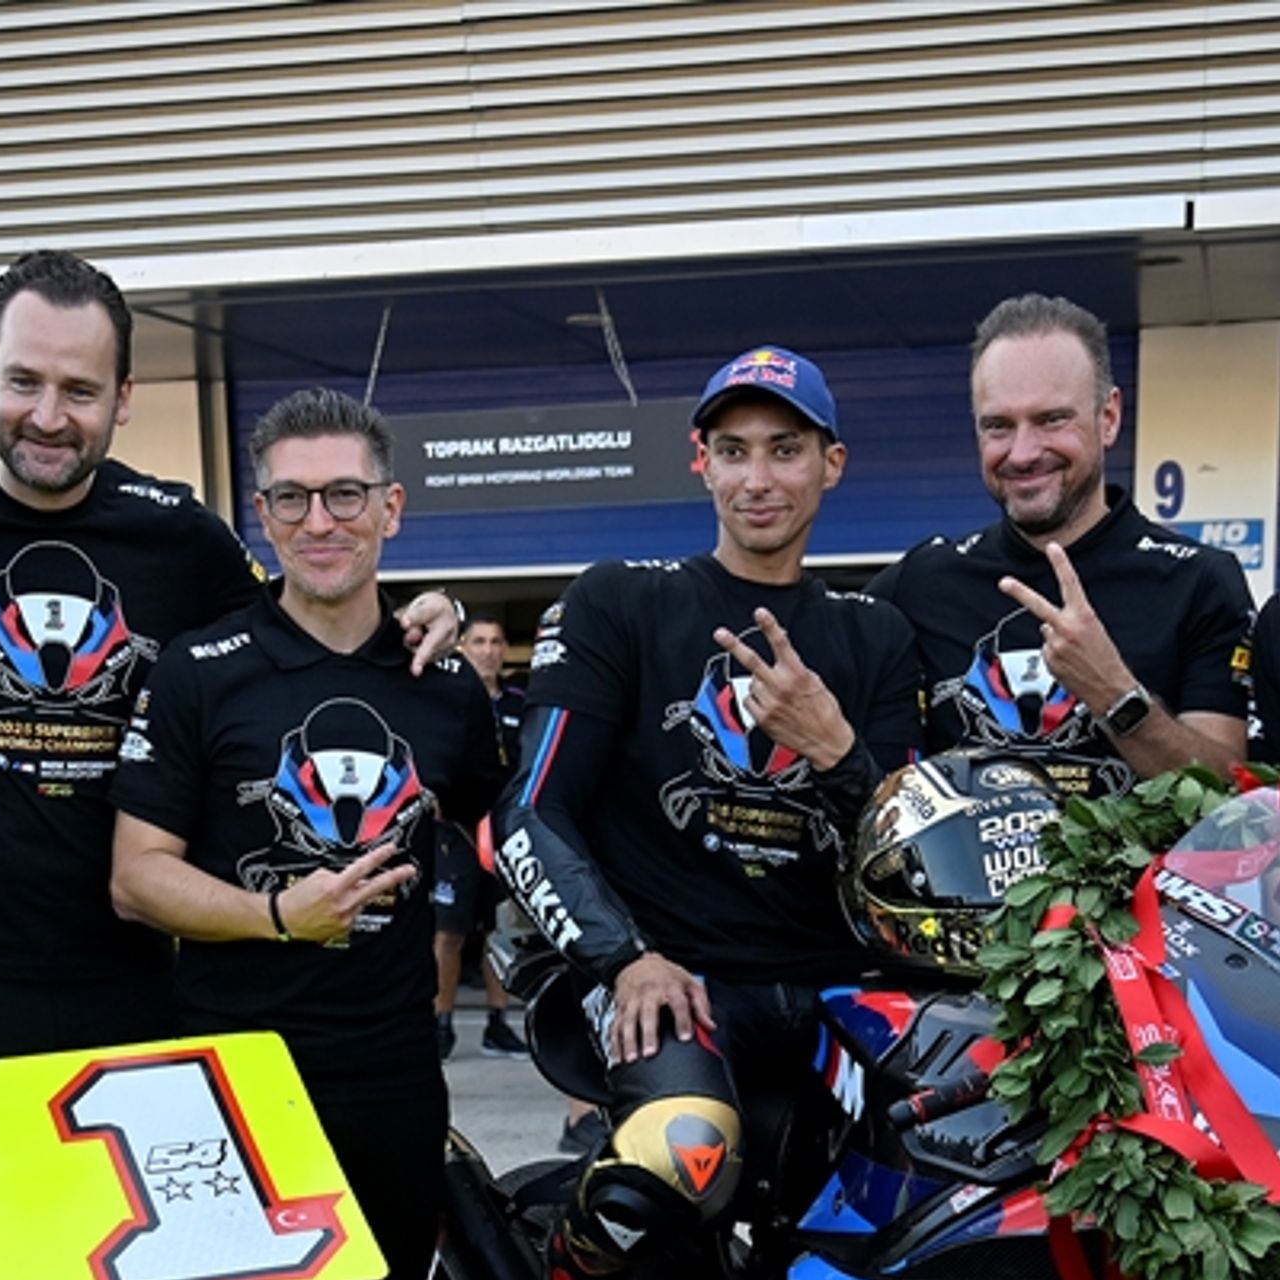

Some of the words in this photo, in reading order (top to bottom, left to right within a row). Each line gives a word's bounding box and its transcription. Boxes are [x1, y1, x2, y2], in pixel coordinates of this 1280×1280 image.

[424, 438, 496, 459] TOPRAK
[1154, 460, 1185, 518] 9
[1200, 521, 1250, 546] NO
[1153, 868, 1244, 922] WRS
